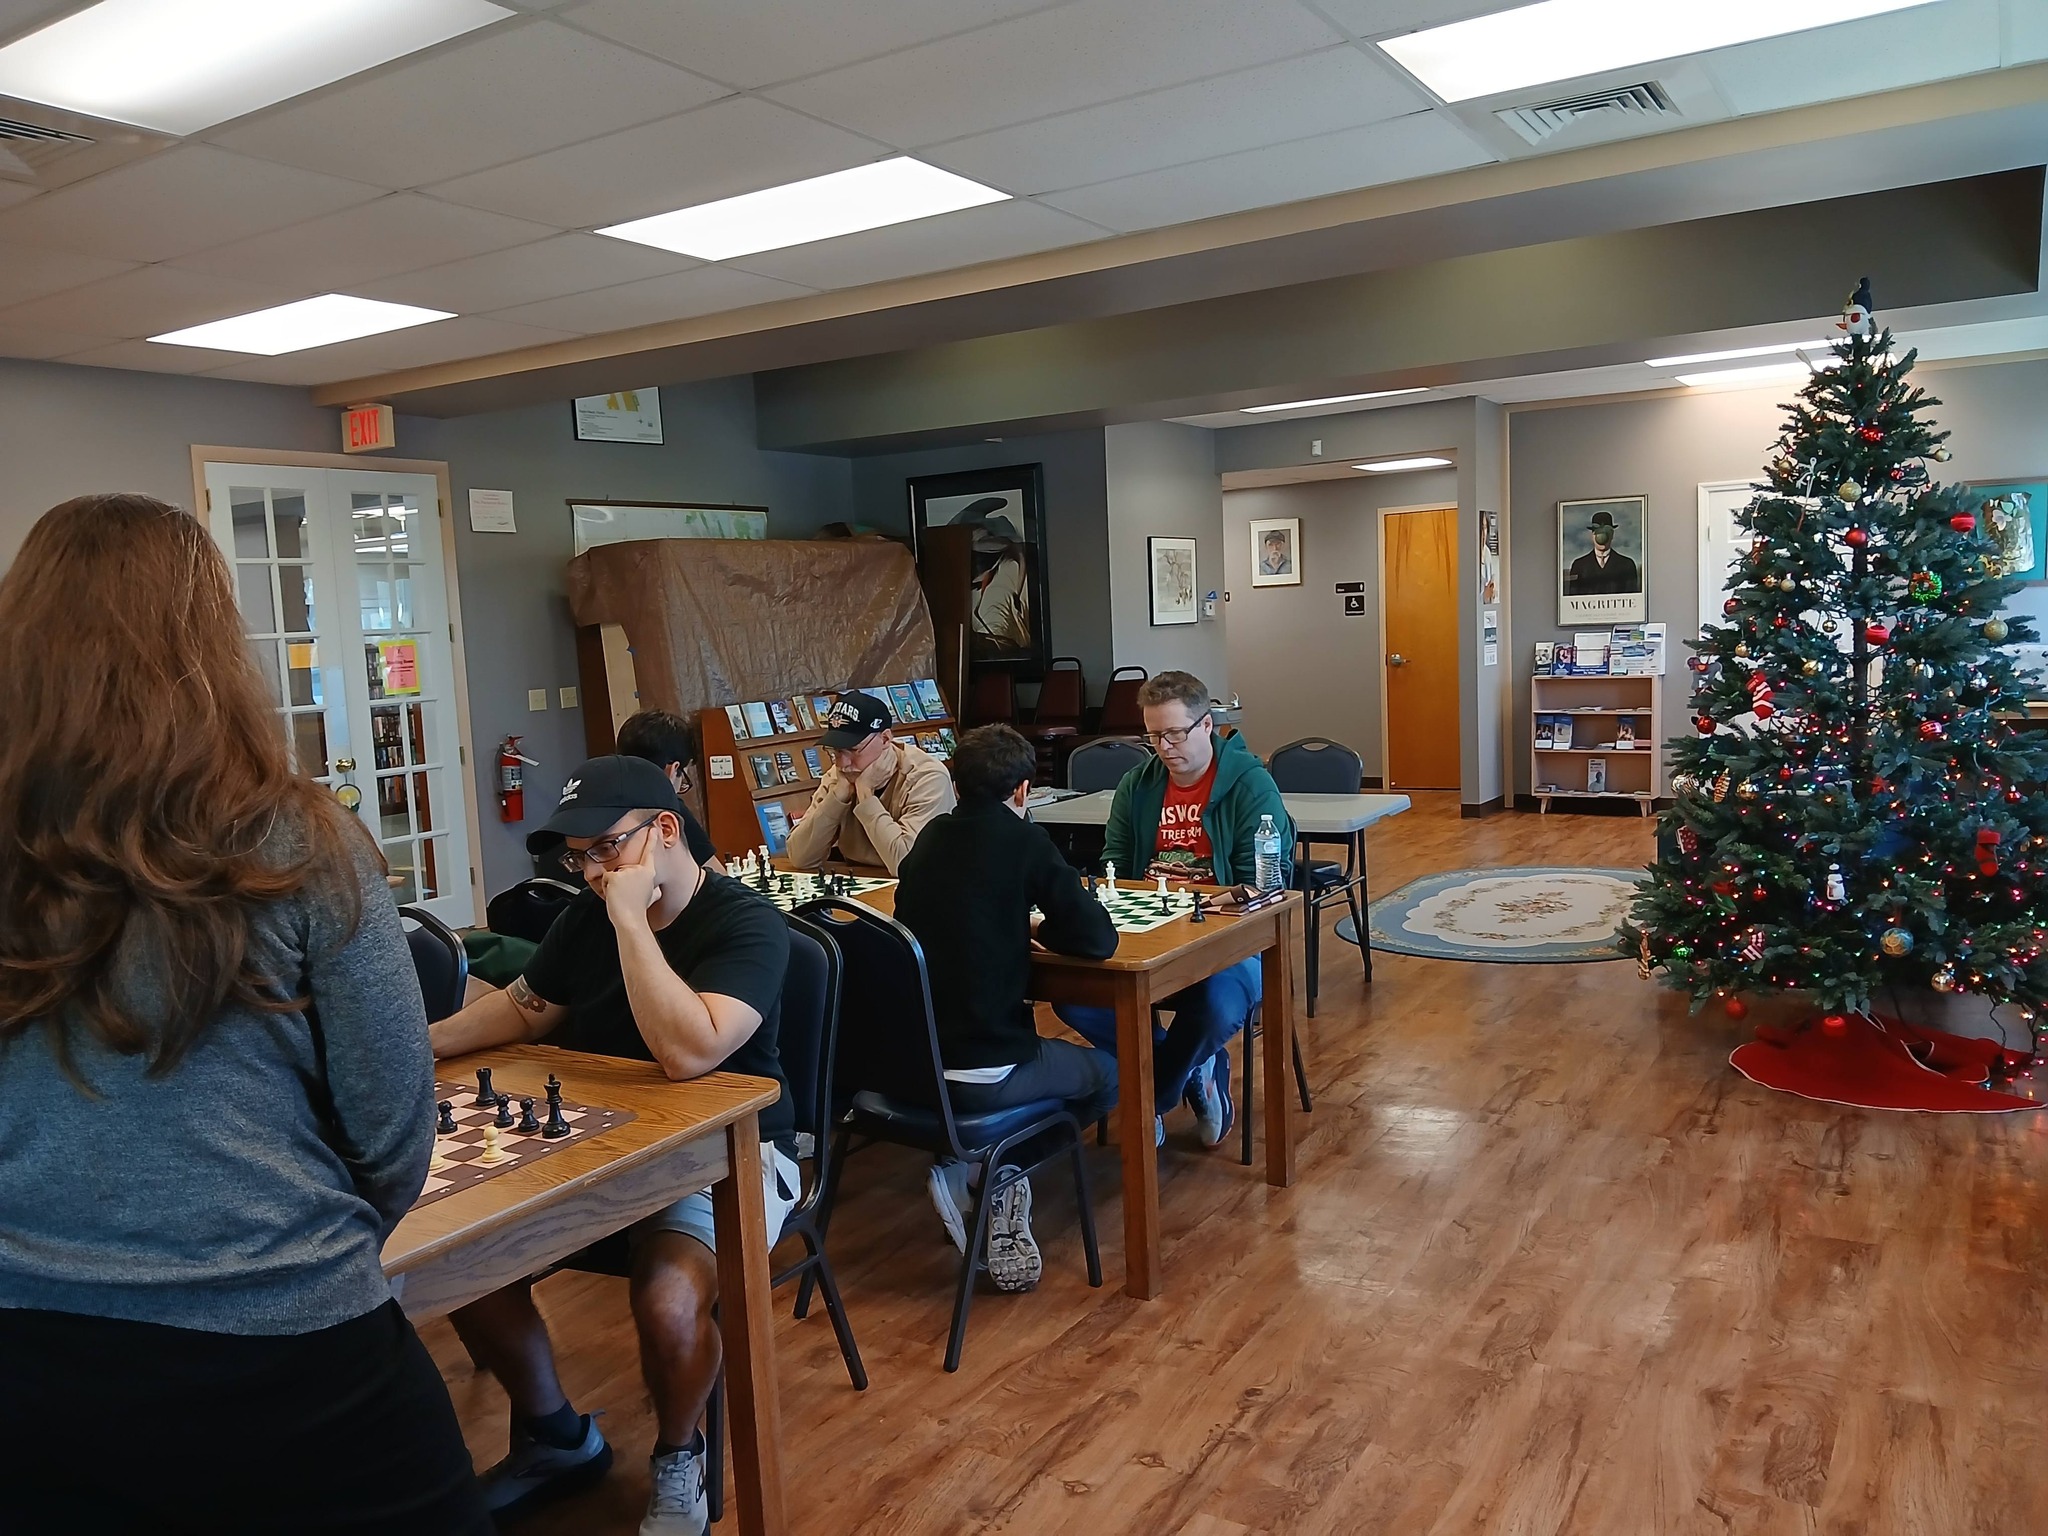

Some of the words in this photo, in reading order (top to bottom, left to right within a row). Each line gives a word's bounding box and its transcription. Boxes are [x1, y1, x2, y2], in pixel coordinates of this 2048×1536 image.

[350, 409, 379, 447] EXIT
[1570, 598, 1637, 611] MAGRITTE
[1160, 829, 1186, 841] TREE
